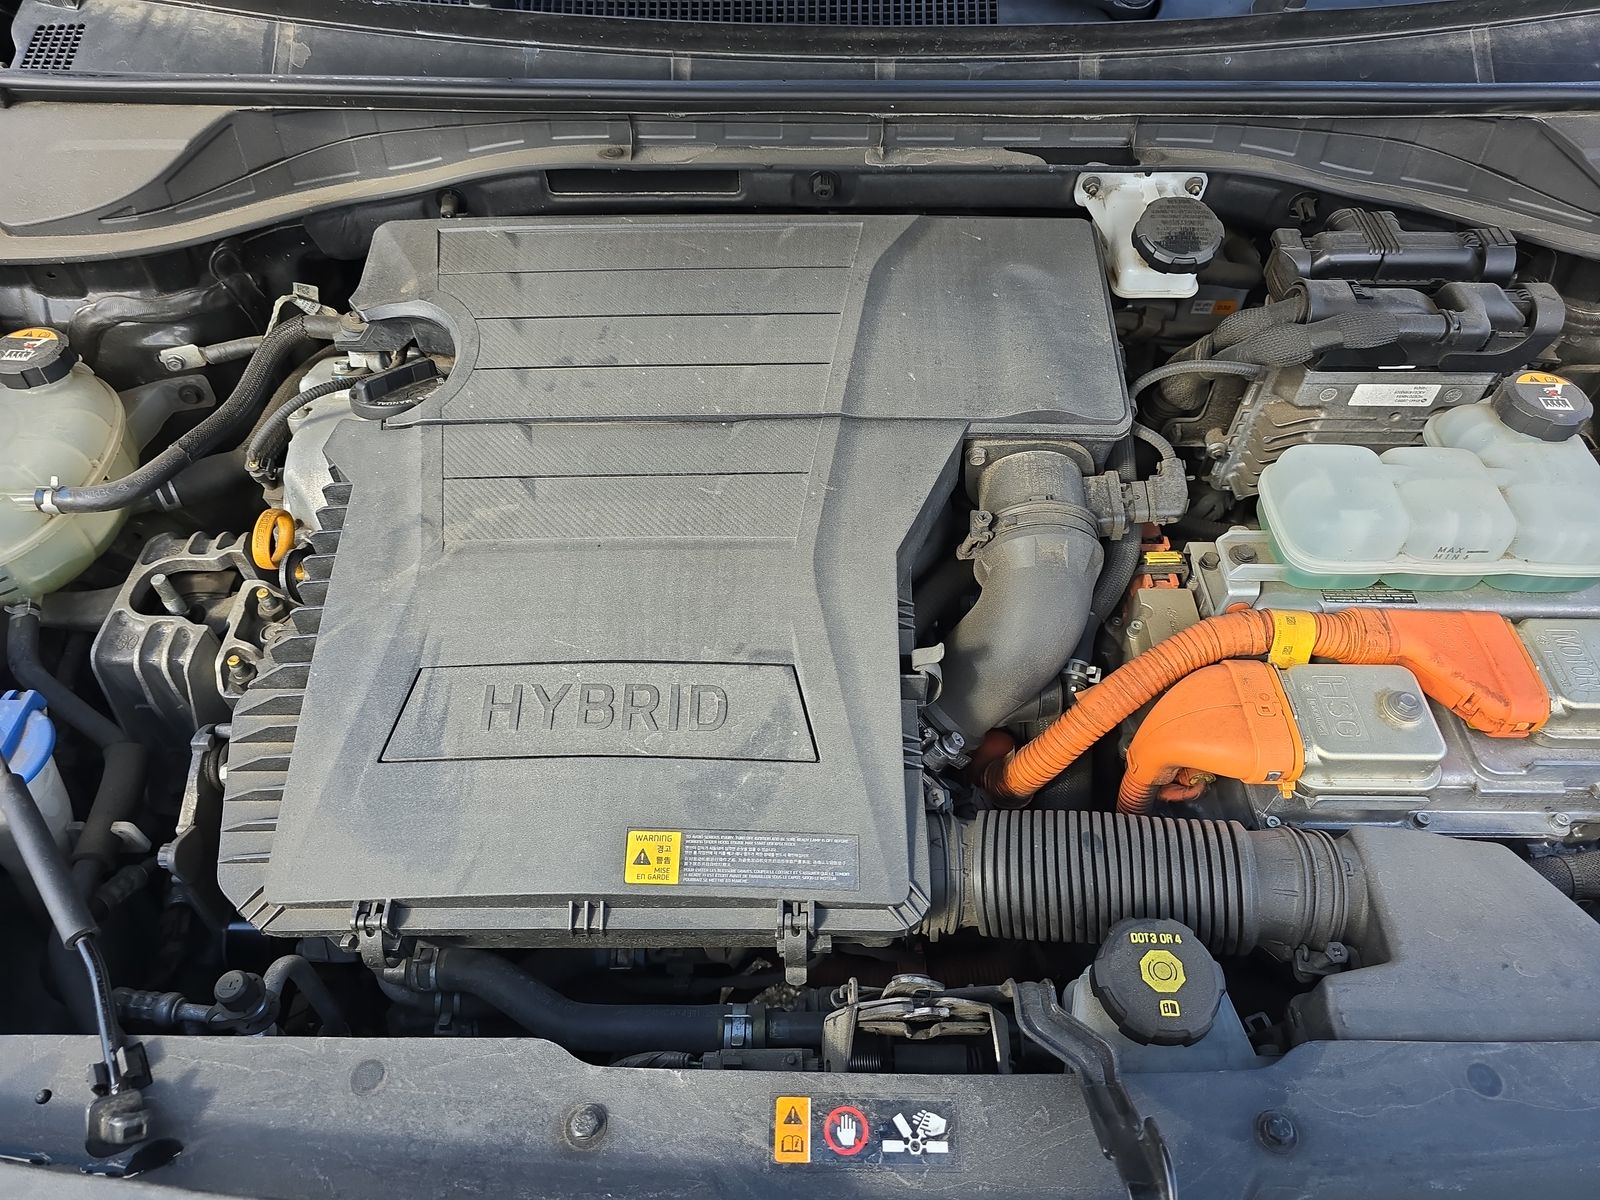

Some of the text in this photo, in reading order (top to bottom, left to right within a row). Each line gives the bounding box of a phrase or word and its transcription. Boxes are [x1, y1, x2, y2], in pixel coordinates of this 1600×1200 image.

[1437, 546, 1465, 554] MAX
[479, 683, 728, 731] HYBRID
[635, 834, 673, 842] WARNING
[657, 844, 672, 854] 경고
[647, 873, 670, 881] GARDE
[1130, 932, 1183, 944] DOT3 OR 4
